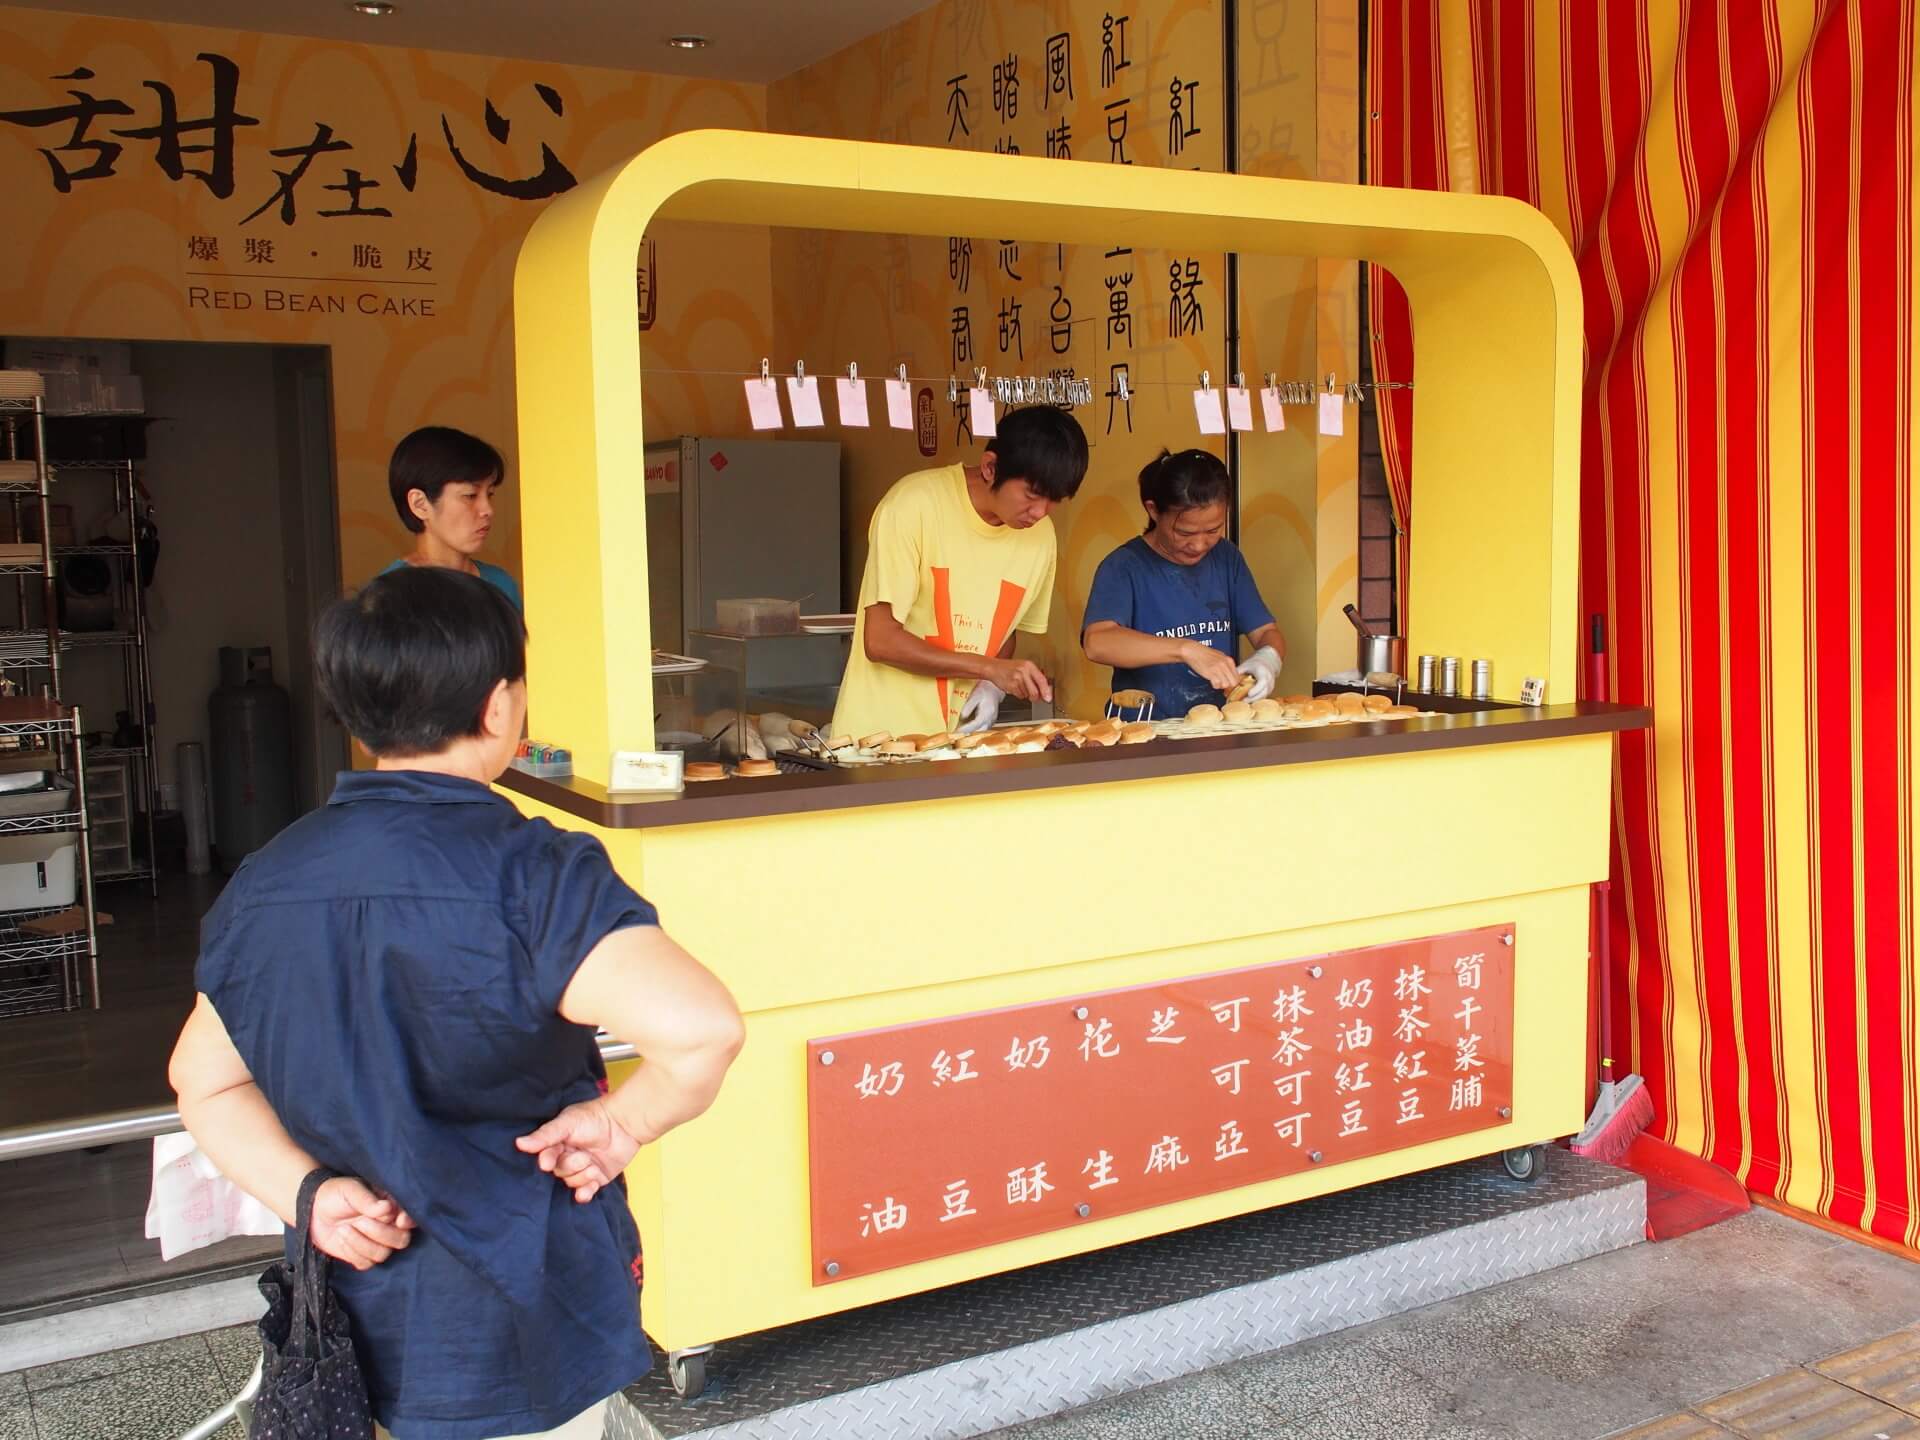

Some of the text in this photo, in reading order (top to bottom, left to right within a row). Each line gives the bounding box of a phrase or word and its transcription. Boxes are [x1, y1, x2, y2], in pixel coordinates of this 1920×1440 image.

[0, 52, 579, 226] 甜在心
[188, 287, 436, 317] RED BEAN CAKE
[953, 614, 972, 628] This
[1078, 1018, 1121, 1190] 花生
[1144, 1006, 1190, 1175] 芝麻
[1210, 997, 1251, 1162] 可可亞
[1272, 985, 1315, 1148] 抹茶可可
[1334, 978, 1374, 1137] 奶油紅豆
[1392, 964, 1432, 1125] 抹茶紅豆
[1448, 953, 1485, 1112] 筍干菜脯
[854, 1061, 908, 1237] 奶油
[931, 1049, 978, 1222] 紅豆
[1004, 1036, 1055, 1204] 奶酥
